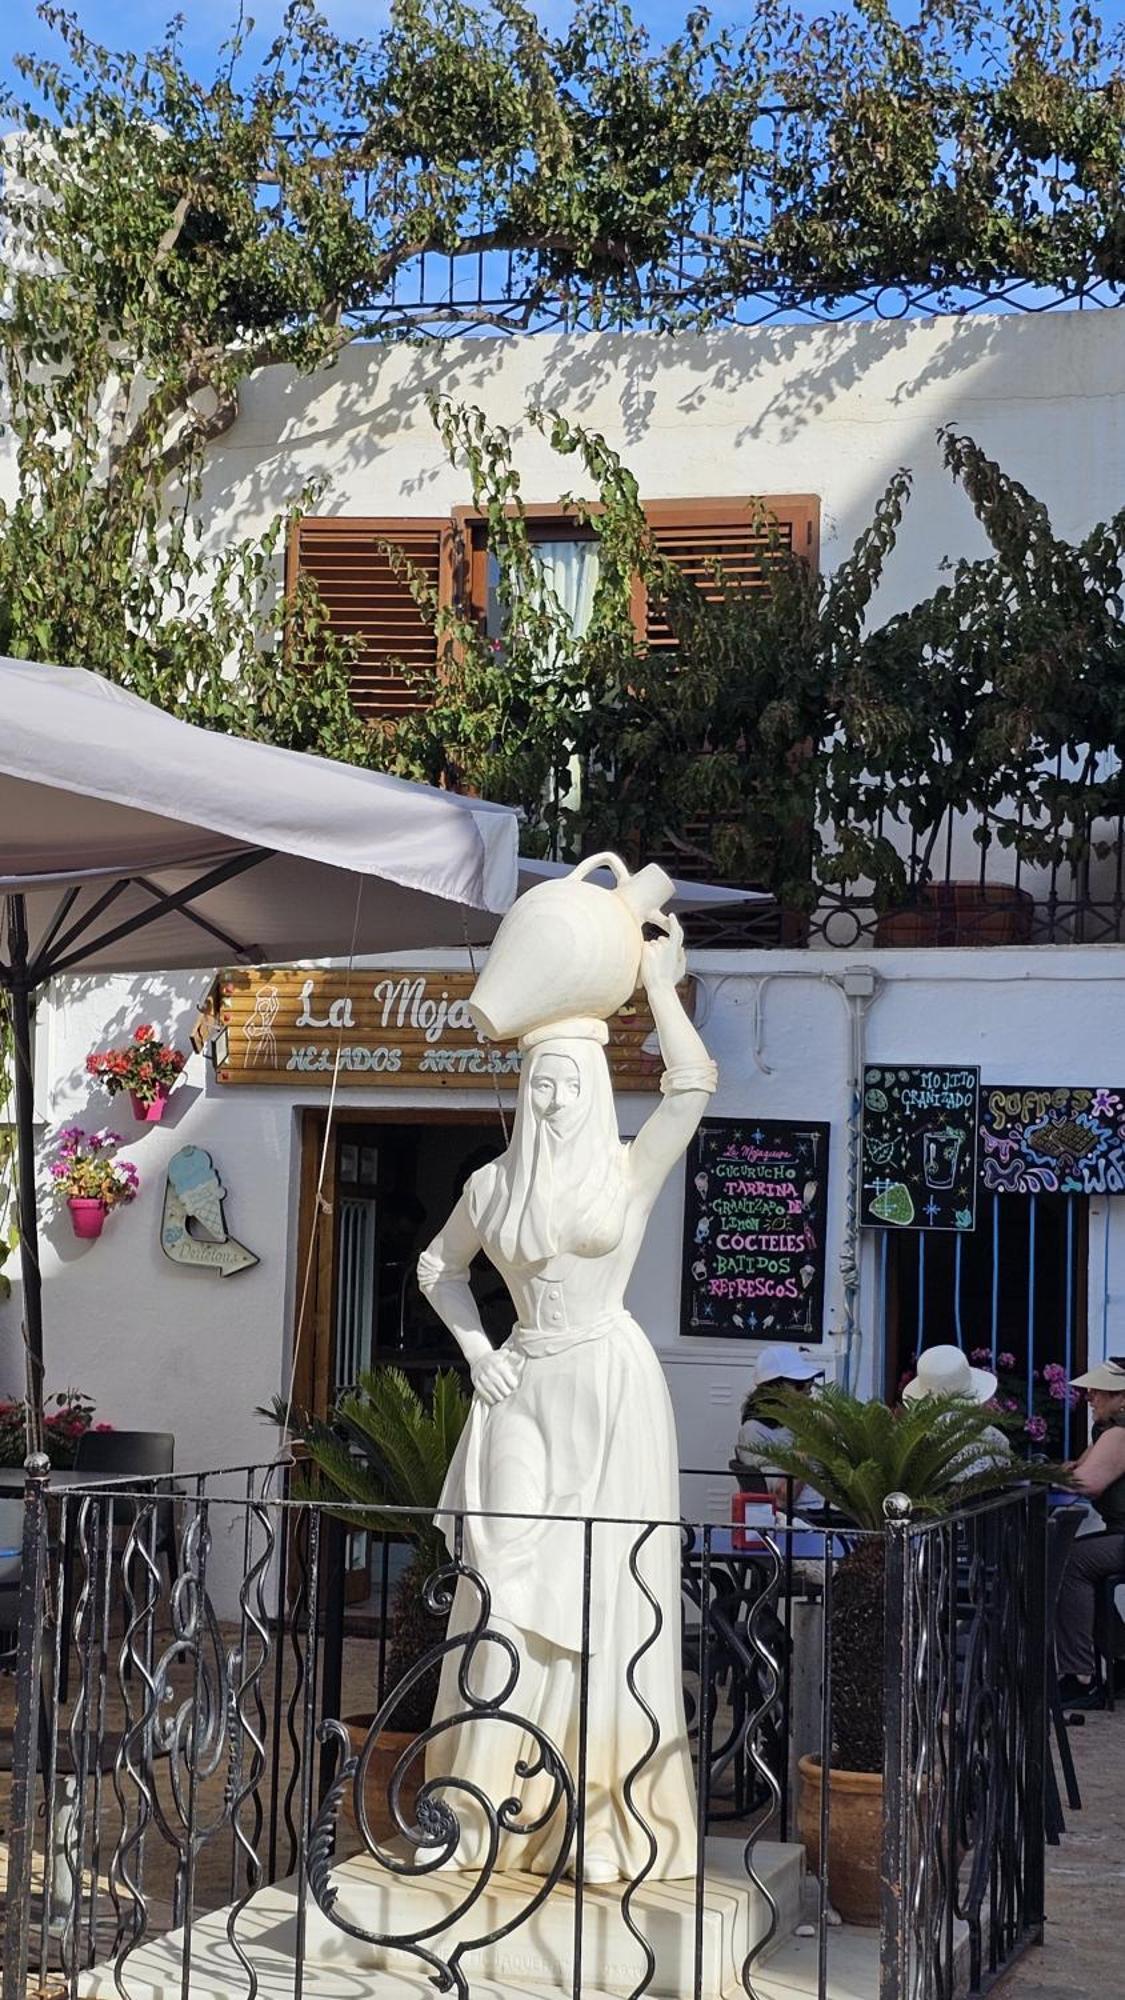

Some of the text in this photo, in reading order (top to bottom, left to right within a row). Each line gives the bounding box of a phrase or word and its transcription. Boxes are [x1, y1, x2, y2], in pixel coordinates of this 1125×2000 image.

[296, 977, 486, 1043] La Moja
[286, 1046, 402, 1072] HELADOS
[920, 1071, 975, 1090] MOJITO
[901, 1089, 973, 1116] GRANIZADO
[716, 1164, 797, 1179] CUCURUCHO
[725, 1180, 799, 1198] TARRINA
[712, 1197, 802, 1216] GRANIZADO DE
[716, 1232, 805, 1253] CÓCTELES
[716, 1254, 791, 1275] BATIDOS
[710, 1278, 798, 1299] REFRESCOS
